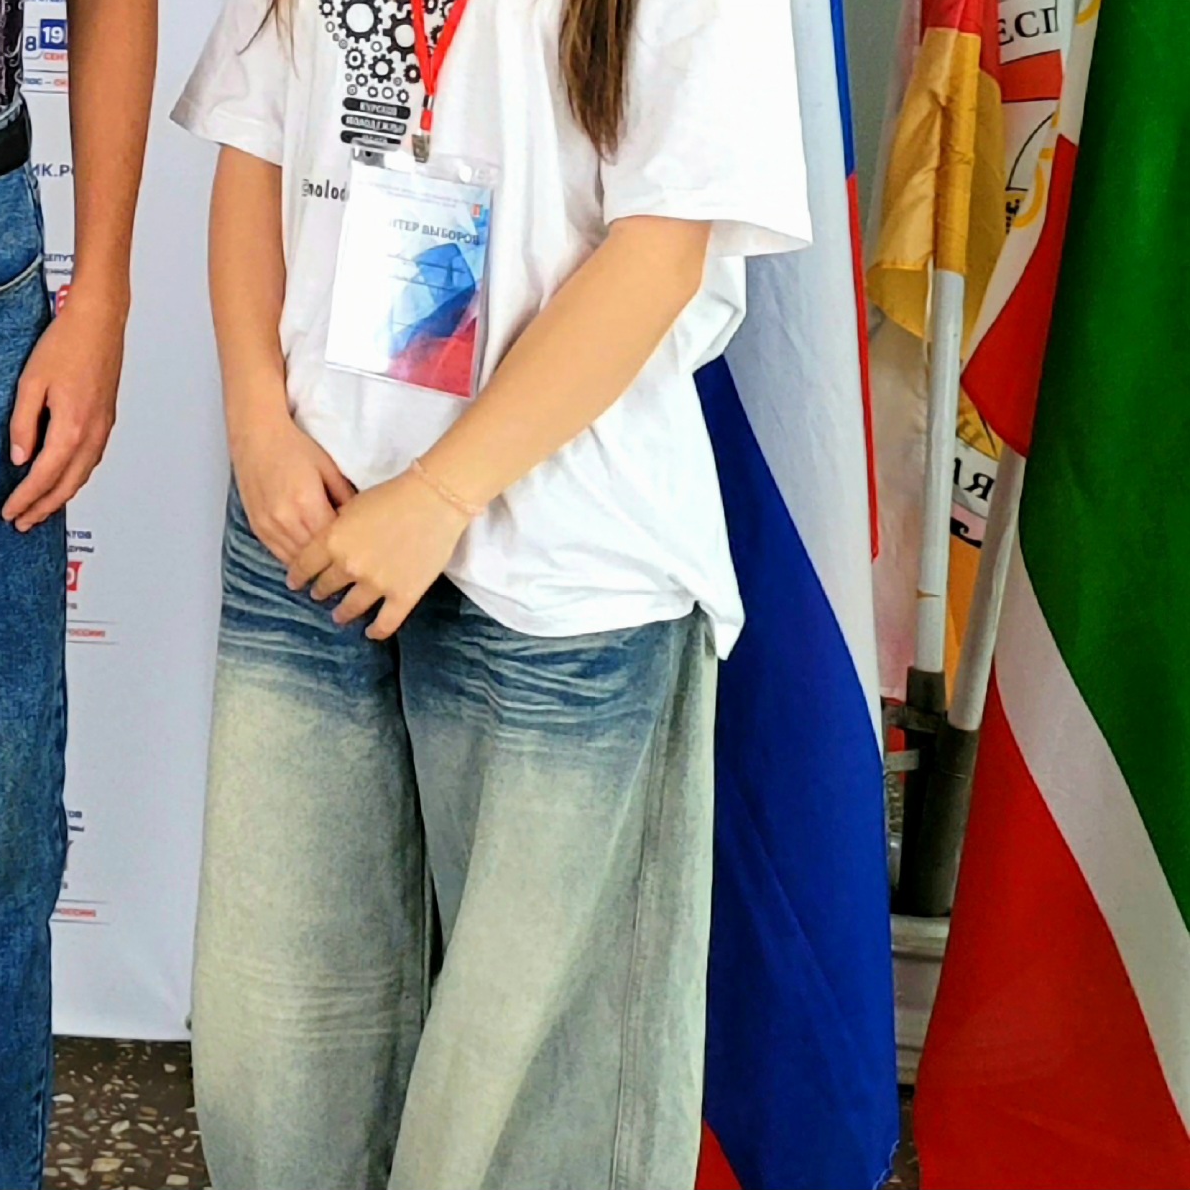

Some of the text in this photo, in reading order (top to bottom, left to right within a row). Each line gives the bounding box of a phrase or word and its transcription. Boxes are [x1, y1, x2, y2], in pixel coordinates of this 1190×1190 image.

[25, 26, 64, 51] 8 19
[31, 163, 73, 177] ИК.Р
